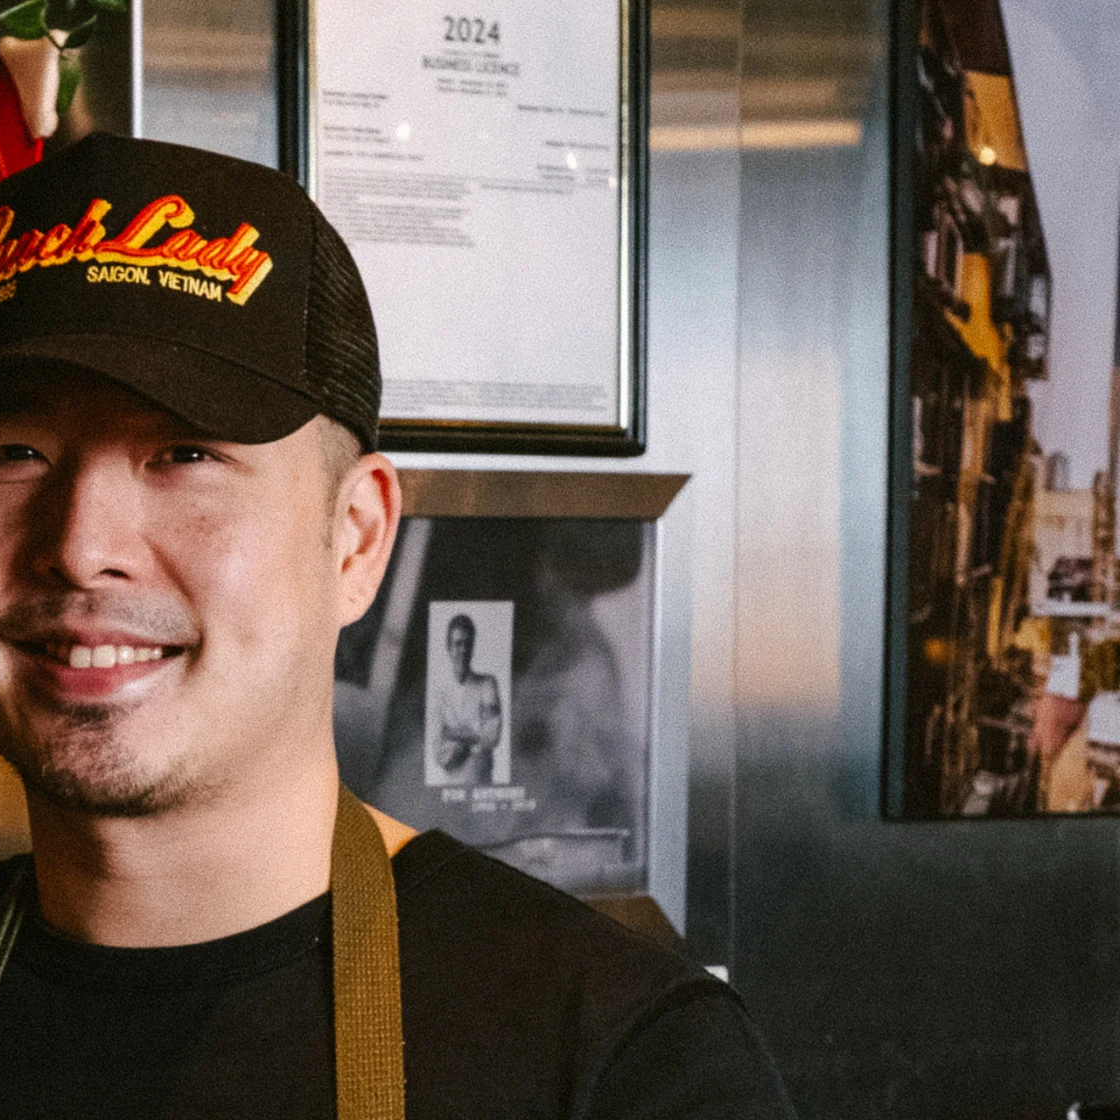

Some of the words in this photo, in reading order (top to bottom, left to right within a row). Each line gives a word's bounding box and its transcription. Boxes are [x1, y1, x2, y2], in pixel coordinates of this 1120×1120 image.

[443, 16, 500, 43] 2024
[93, 194, 274, 306] Lady
[158, 269, 222, 302] VIETNAM
